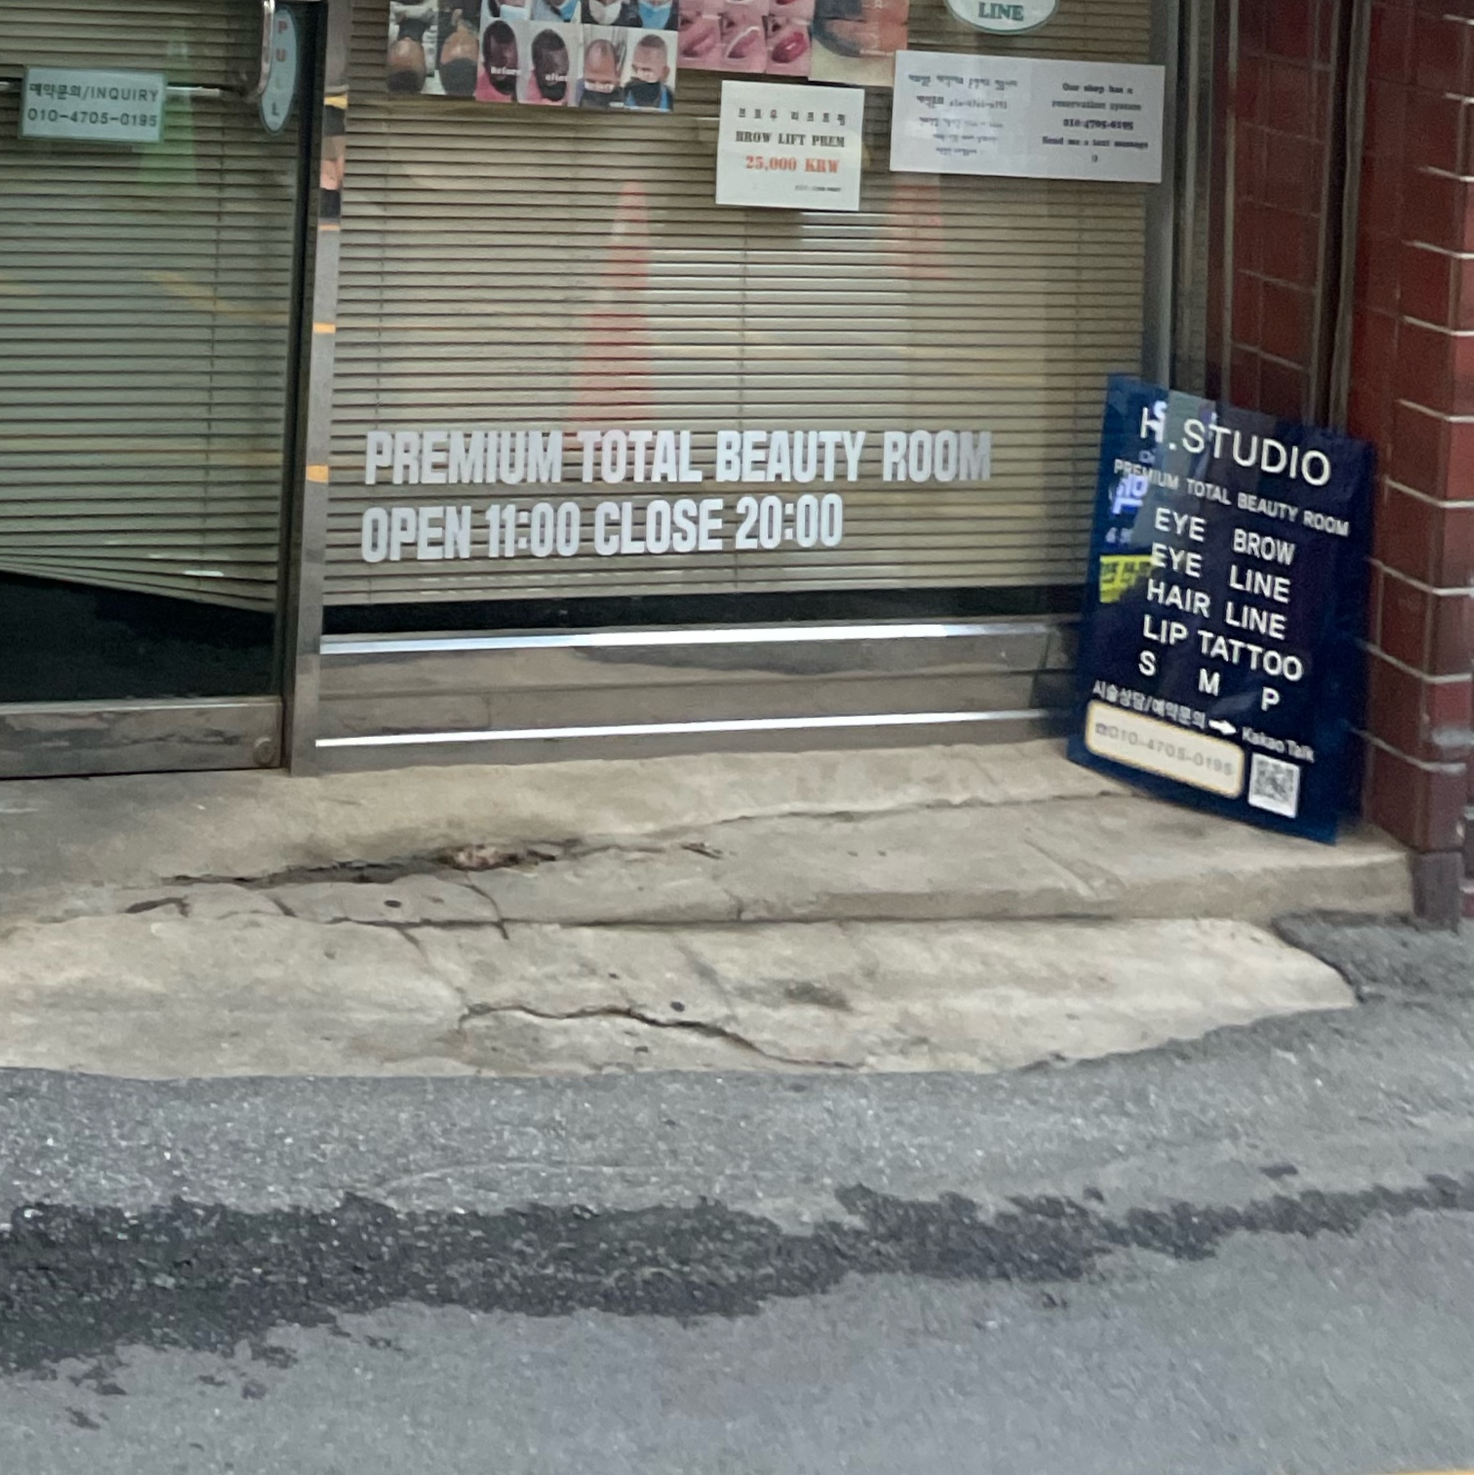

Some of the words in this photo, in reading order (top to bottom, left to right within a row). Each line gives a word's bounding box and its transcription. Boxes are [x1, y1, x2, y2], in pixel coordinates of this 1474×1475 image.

[979, 2, 1024, 21] LINE
[745, 155, 797, 172] 25,000
[778, 133, 806, 146] LIFT
[365, 430, 563, 484] PREMIUM
[577, 429, 702, 484] TOTAL
[715, 429, 866, 483] BEAUTY
[883, 429, 992, 482] ROOM
[1140, 406, 1332, 486] H.STUDIO
[361, 505, 471, 563] OPEN
[485, 501, 580, 557] 11:00
[594, 497, 724, 556] CLOSE
[735, 493, 843, 549] 20:00
[1114, 458, 1179, 490] PREMIUM
[1186, 477, 1232, 506] TOTAL
[1237, 491, 1298, 522] BEAUTY
[1302, 509, 1350, 537] ROOM
[1155, 507, 1206, 542] EYE
[1233, 528, 1296, 565] BROW
[1150, 541, 1203, 578] EYE
[1230, 564, 1291, 604] LINE
[1147, 578, 1211, 618] HAIR
[1225, 601, 1288, 640] LINE
[1143, 614, 1189, 645] LIP
[1197, 629, 1304, 682] TATTOO
[1138, 650, 1156, 676] S
[1198, 668, 1220, 696] M
[1261, 686, 1280, 711] P
